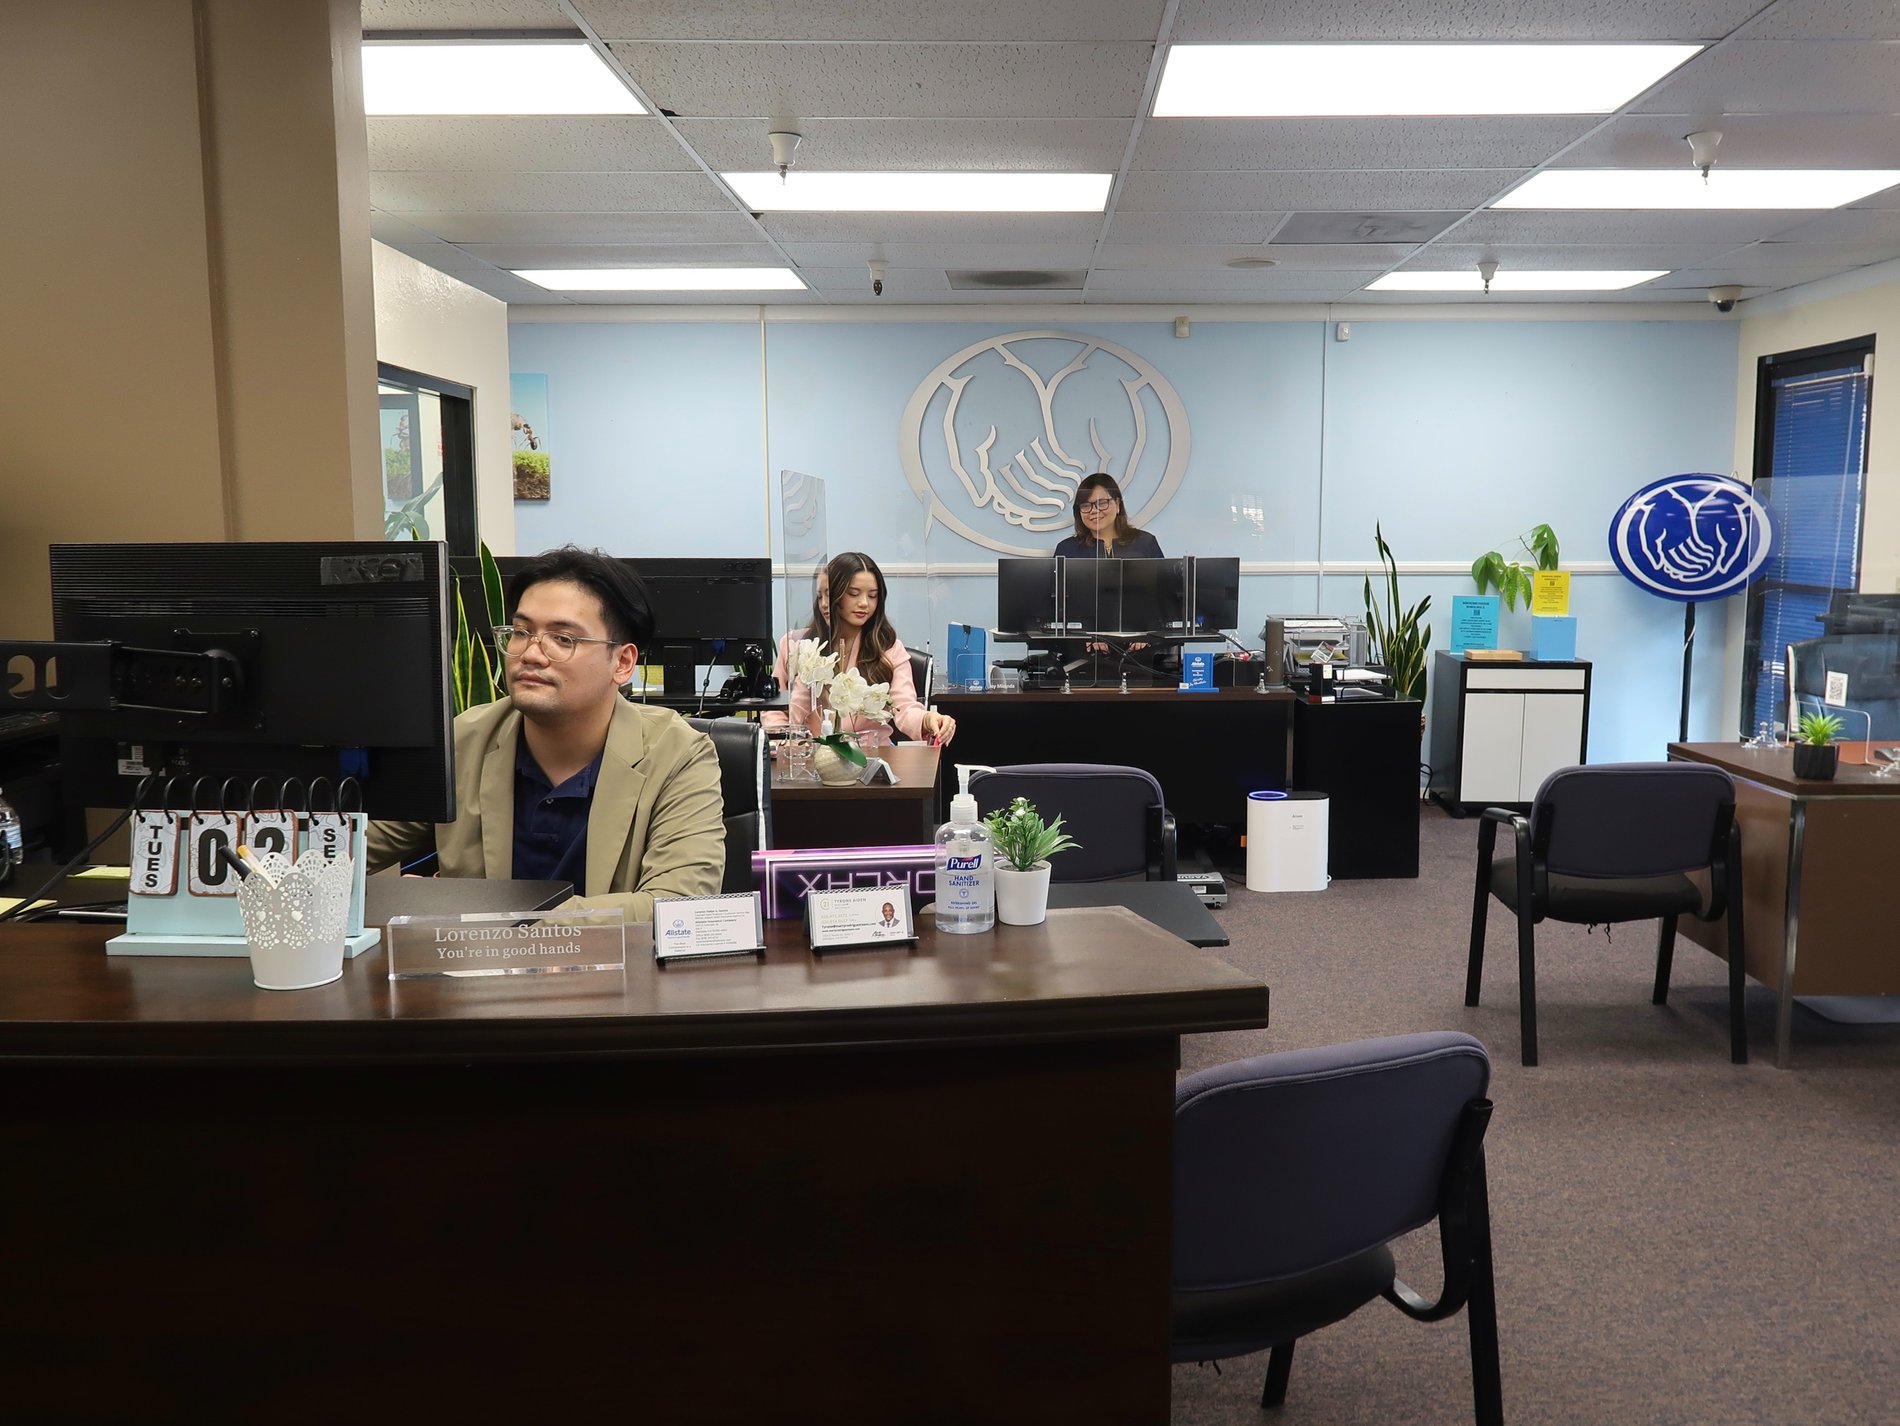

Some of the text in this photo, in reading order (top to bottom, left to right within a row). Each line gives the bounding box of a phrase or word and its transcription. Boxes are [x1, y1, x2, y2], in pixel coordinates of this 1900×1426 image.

[145, 826, 163, 888] TUES
[323, 828, 336, 864] SE
[950, 857, 979, 869] Purell
[434, 924, 582, 942] Lorenzo Santos
[664, 929, 692, 937] Allstate
[437, 942, 581, 959] You're in good hands
